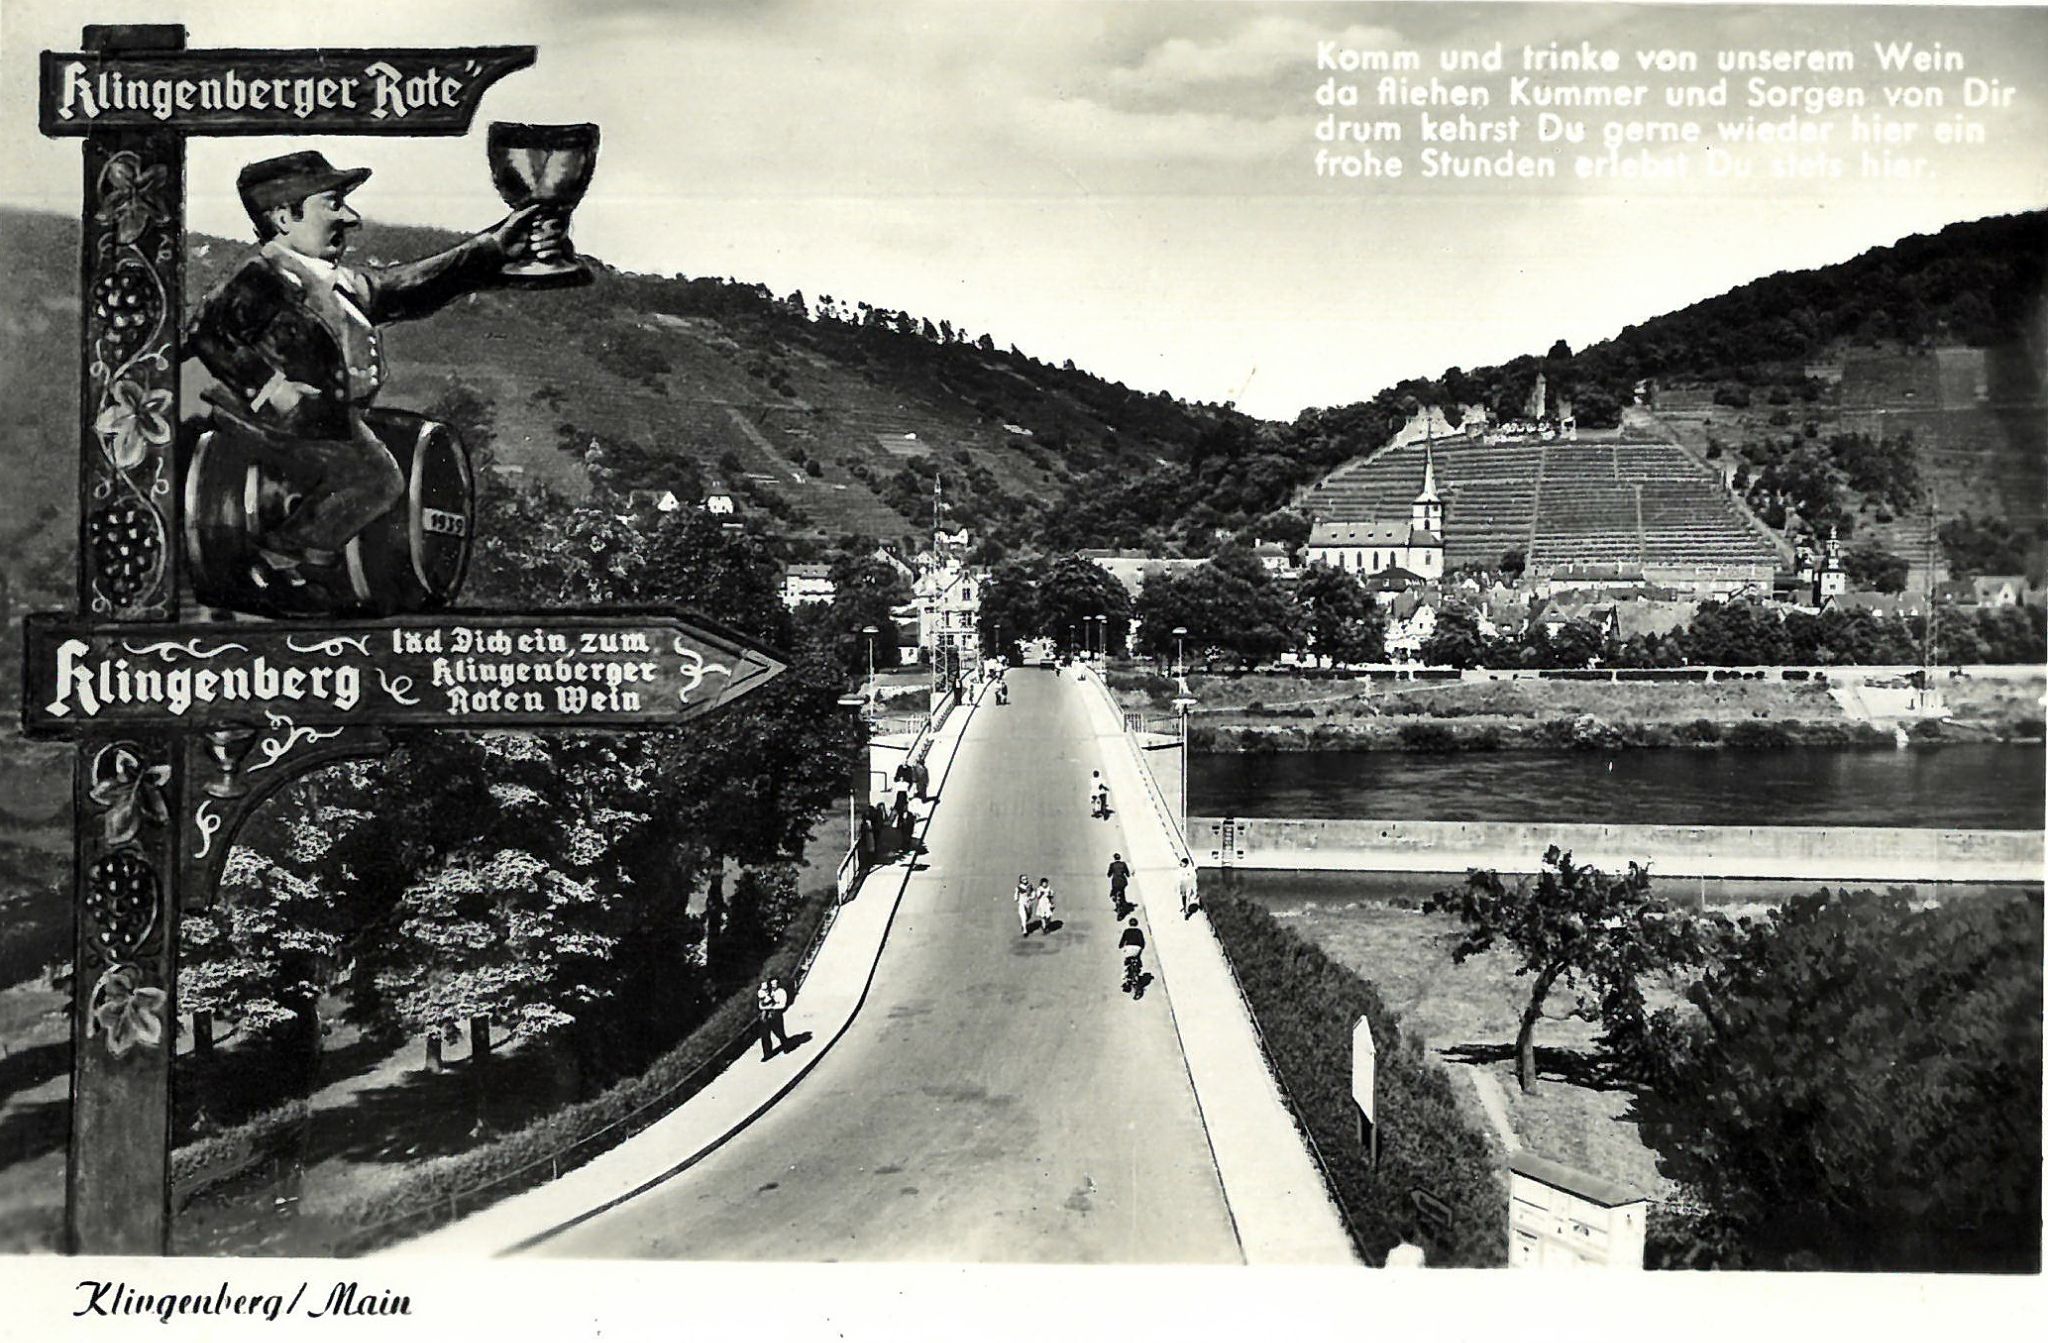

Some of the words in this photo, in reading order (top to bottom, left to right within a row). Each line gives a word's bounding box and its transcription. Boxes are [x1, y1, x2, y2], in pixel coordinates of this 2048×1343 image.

[58, 61, 359, 121] Klingenberger
[430, 512, 465, 535] 1939
[450, 626, 513, 656] Dich
[579, 632, 650, 654] zum
[45, 638, 360, 717] Klingenberg
[431, 656, 658, 688] Klingenberger
[446, 685, 545, 715] Roten
[554, 684, 643, 715] Wein
